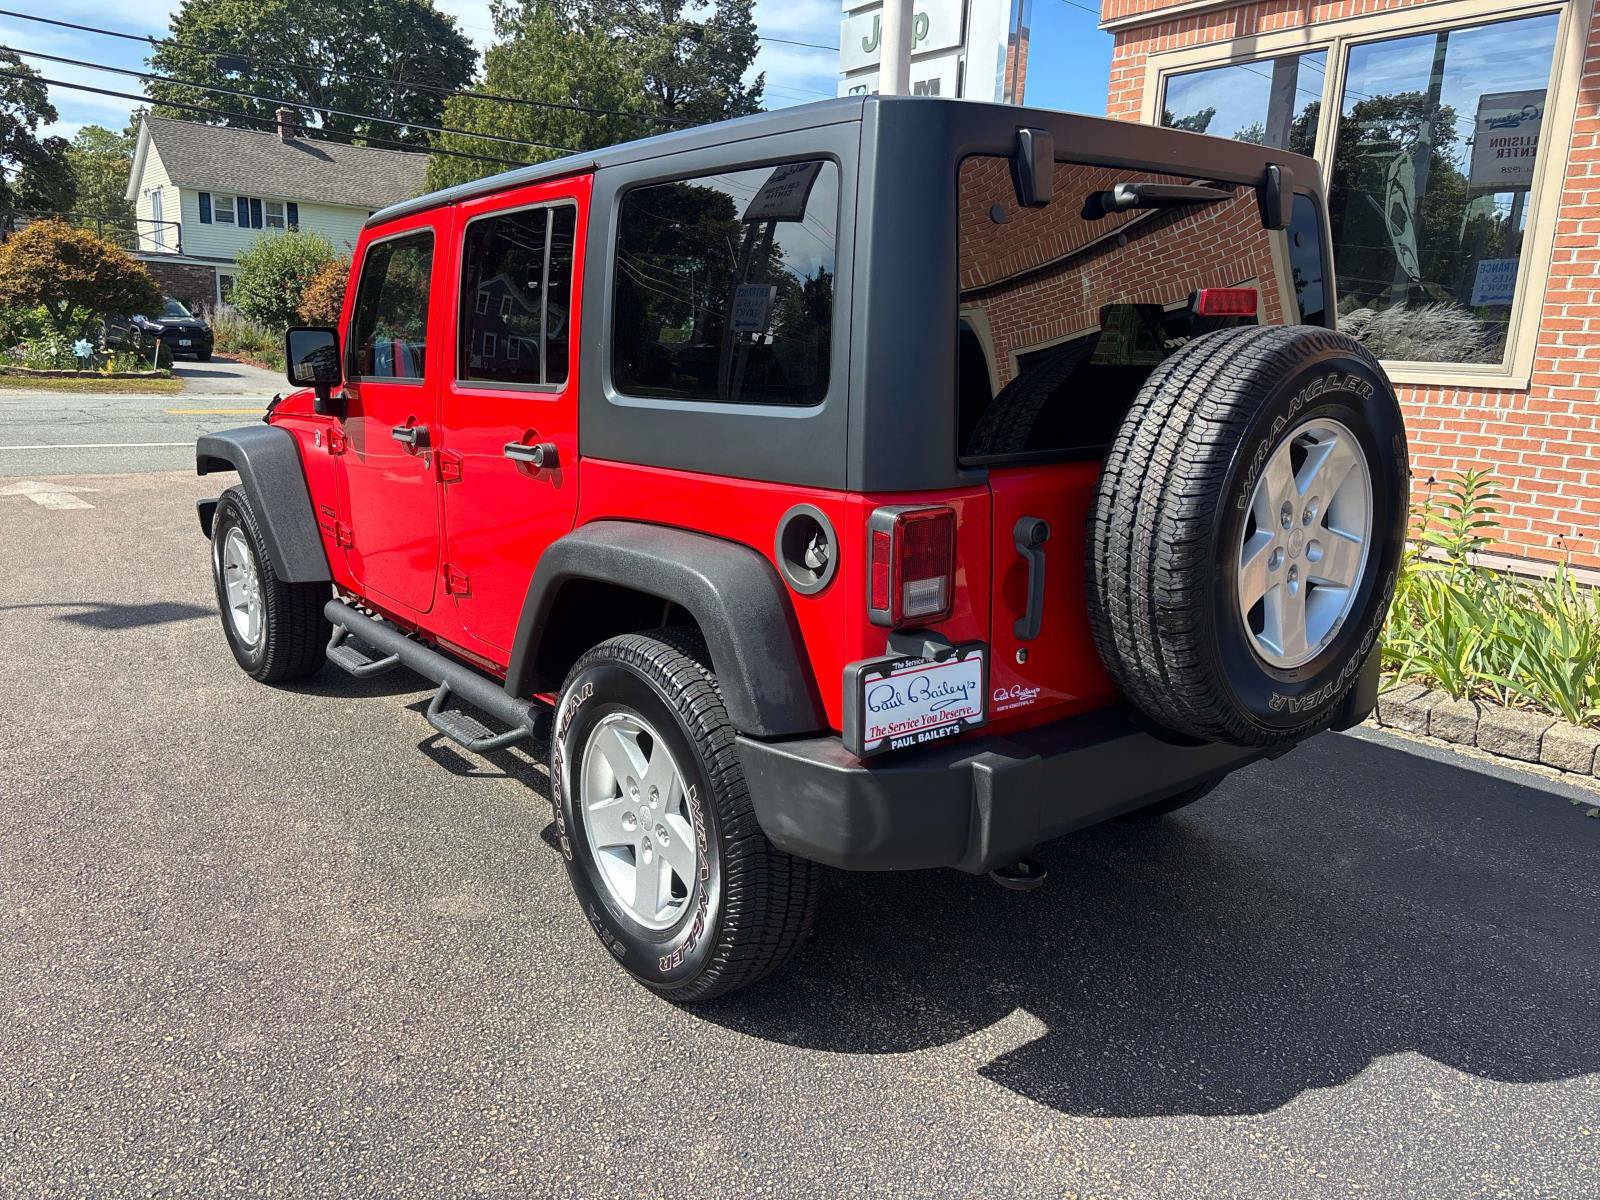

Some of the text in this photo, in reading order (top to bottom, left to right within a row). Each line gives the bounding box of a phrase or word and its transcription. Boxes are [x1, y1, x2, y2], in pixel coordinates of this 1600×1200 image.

[862, 12, 929, 53] Jp
[1237, 373, 1374, 510] WRANGLER
[905, 657, 924, 667] Service
[1268, 571, 1395, 714] GOODYEAR
[868, 675, 976, 712] Paul Bailey's
[870, 706, 974, 738] The Service You Deserve.
[891, 725, 960, 750] PAUL BAILEY'S
[553, 682, 593, 861] GOODYEAR
[659, 784, 710, 972] WRANGLER
